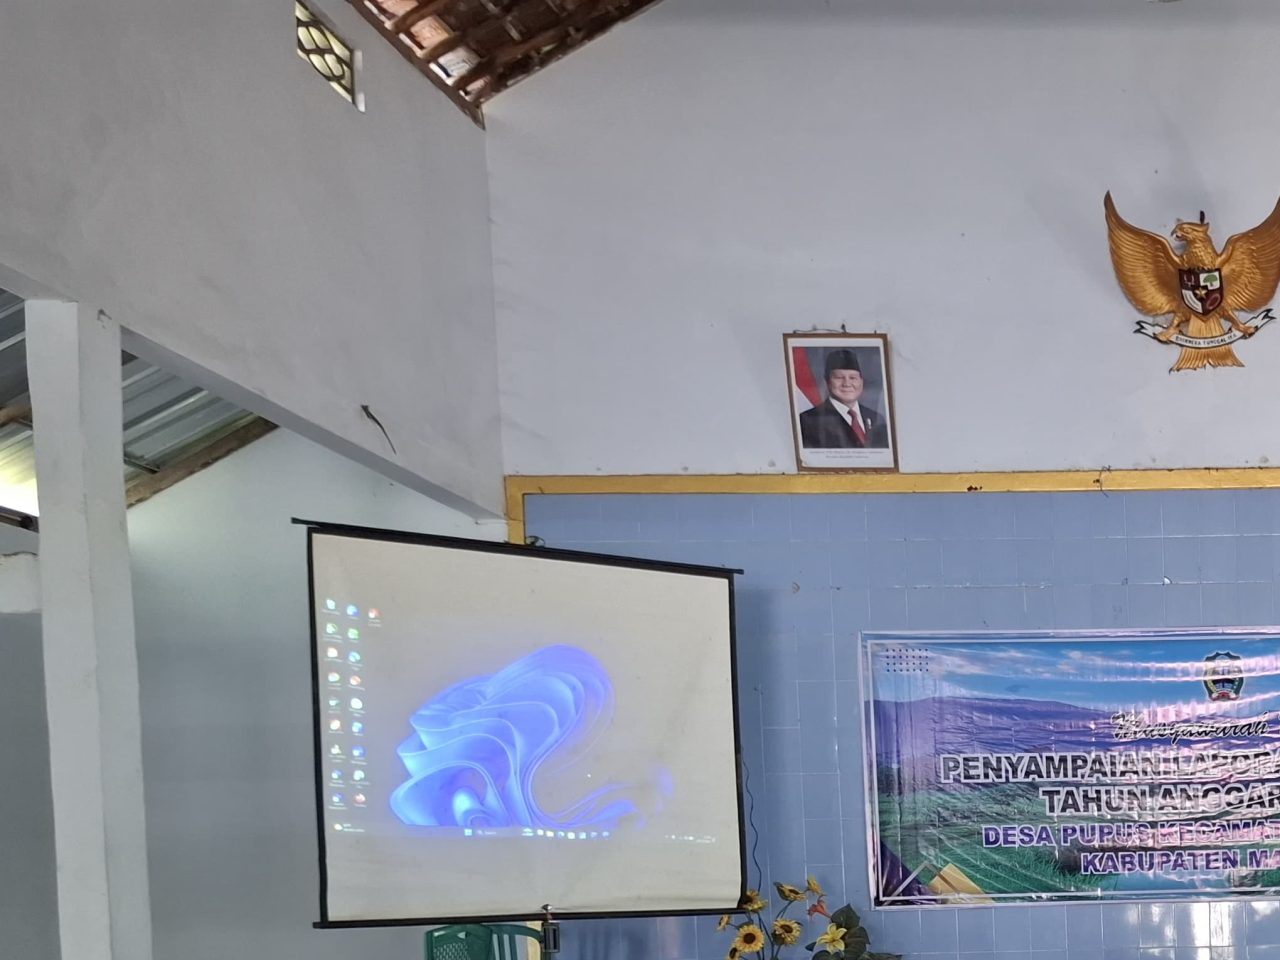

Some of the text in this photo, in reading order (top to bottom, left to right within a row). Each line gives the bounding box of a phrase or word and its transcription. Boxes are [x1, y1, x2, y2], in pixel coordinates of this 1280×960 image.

[941, 752, 1162, 783] PENYAMPAIAN
[1039, 785, 1149, 815] TAHUN
[982, 825, 1056, 847] DESA
[1061, 823, 1150, 845] PUPUS
[1081, 847, 1240, 875] KABUPATEN
